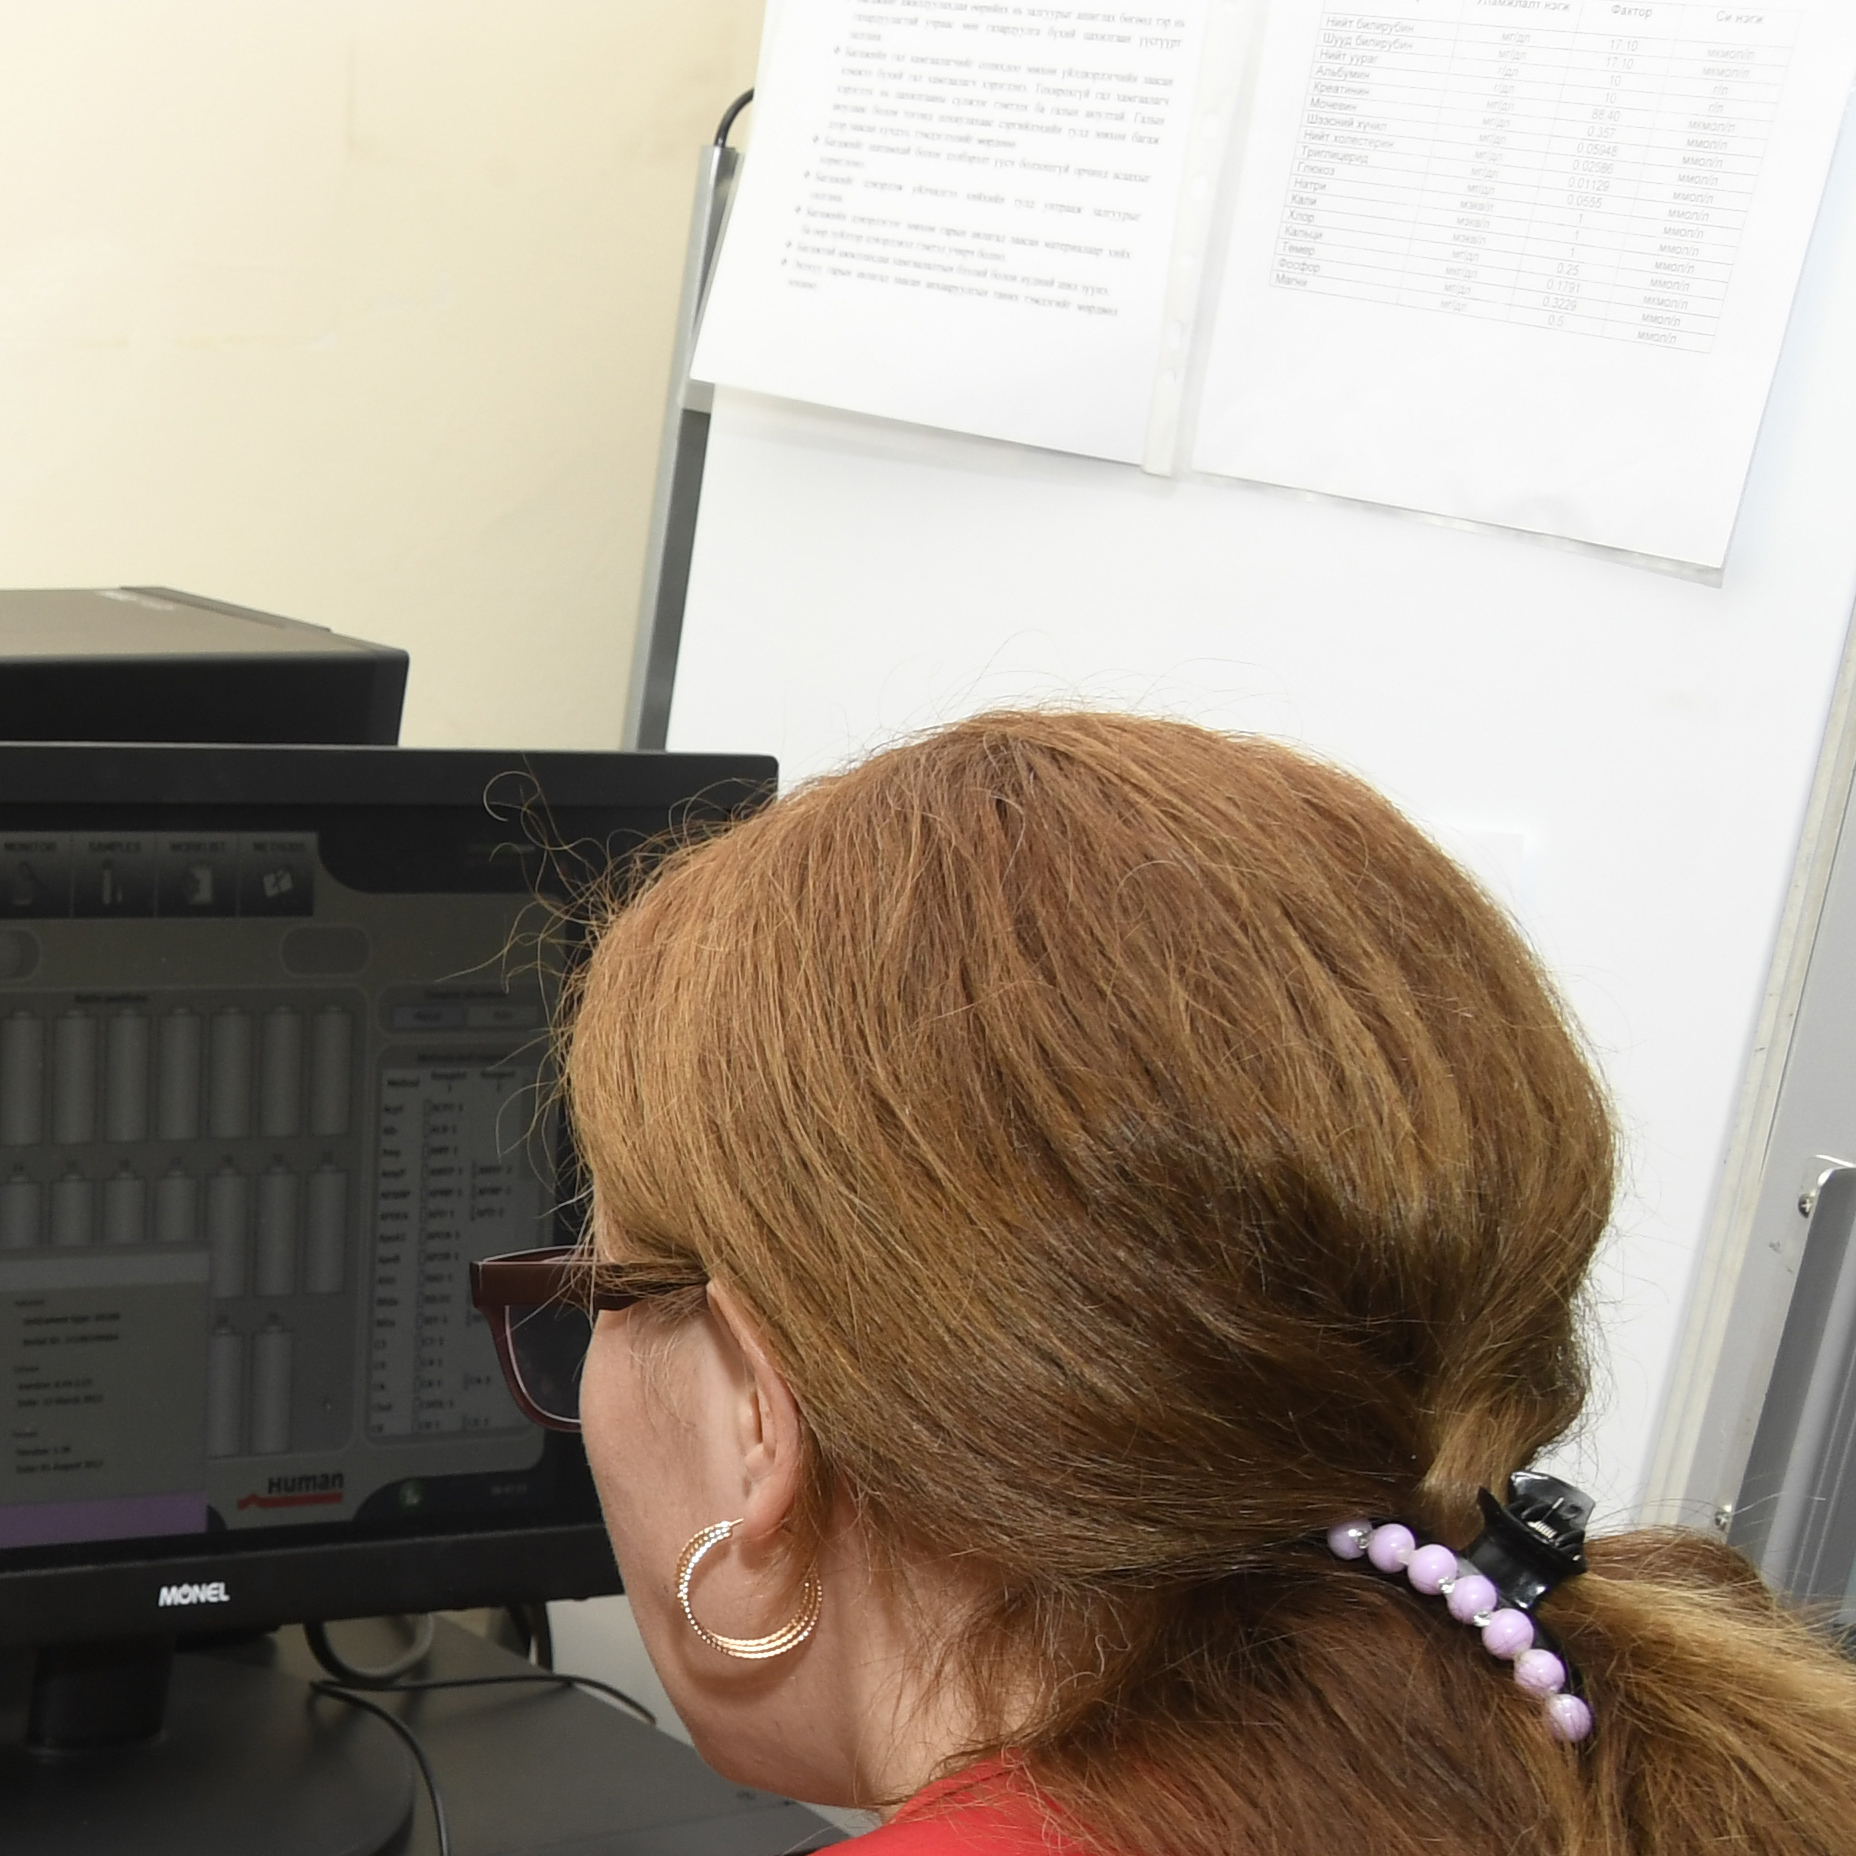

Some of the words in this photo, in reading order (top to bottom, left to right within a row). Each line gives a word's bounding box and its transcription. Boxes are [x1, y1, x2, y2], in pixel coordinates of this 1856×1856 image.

[1611, 4, 1653, 20] Фактор
[1609, 74, 1623, 87] 10
[1605, 92, 1618, 105] 10
[266, 1471, 345, 1495] Human
